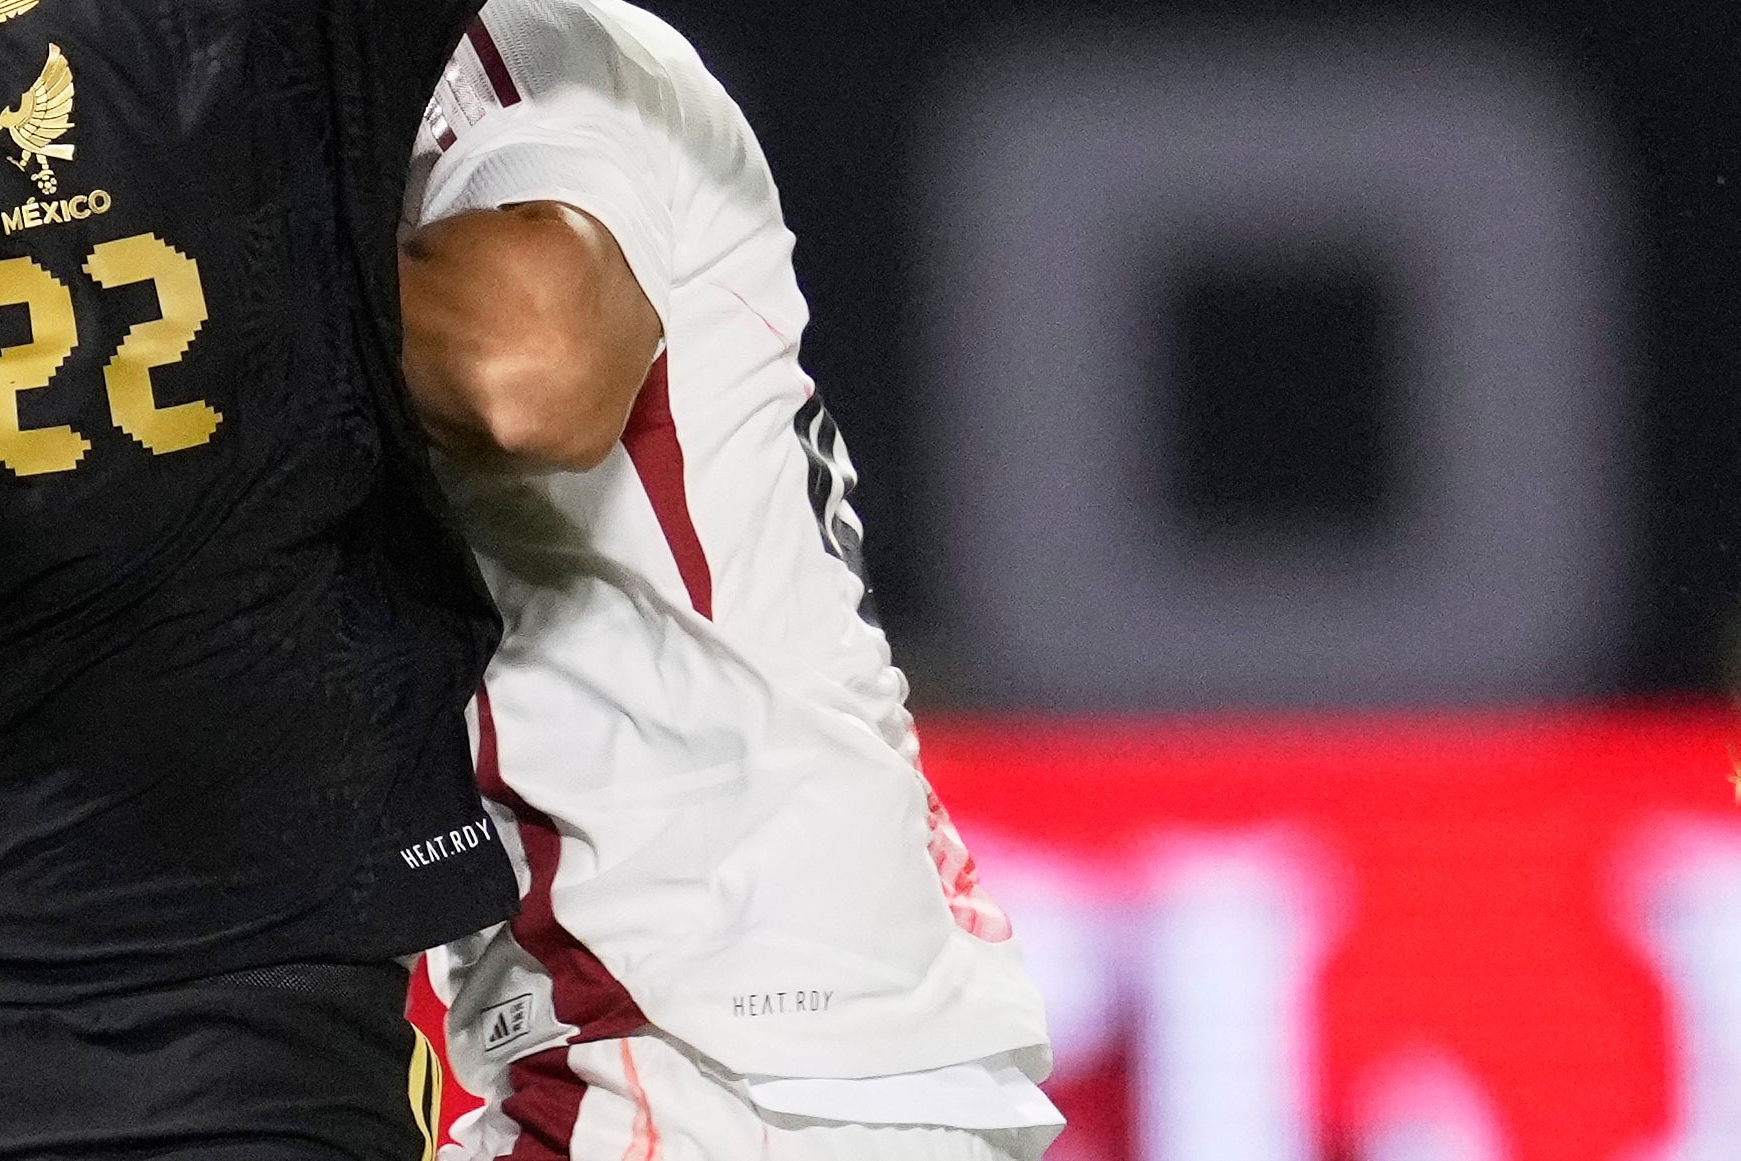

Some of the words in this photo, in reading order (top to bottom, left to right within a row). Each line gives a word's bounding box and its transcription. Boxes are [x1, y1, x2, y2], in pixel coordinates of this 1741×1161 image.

[0, 189, 112, 235] MÉXICO
[400, 818, 491, 869] HEAT.RDY
[733, 990, 834, 1016] HEAT.RDY
